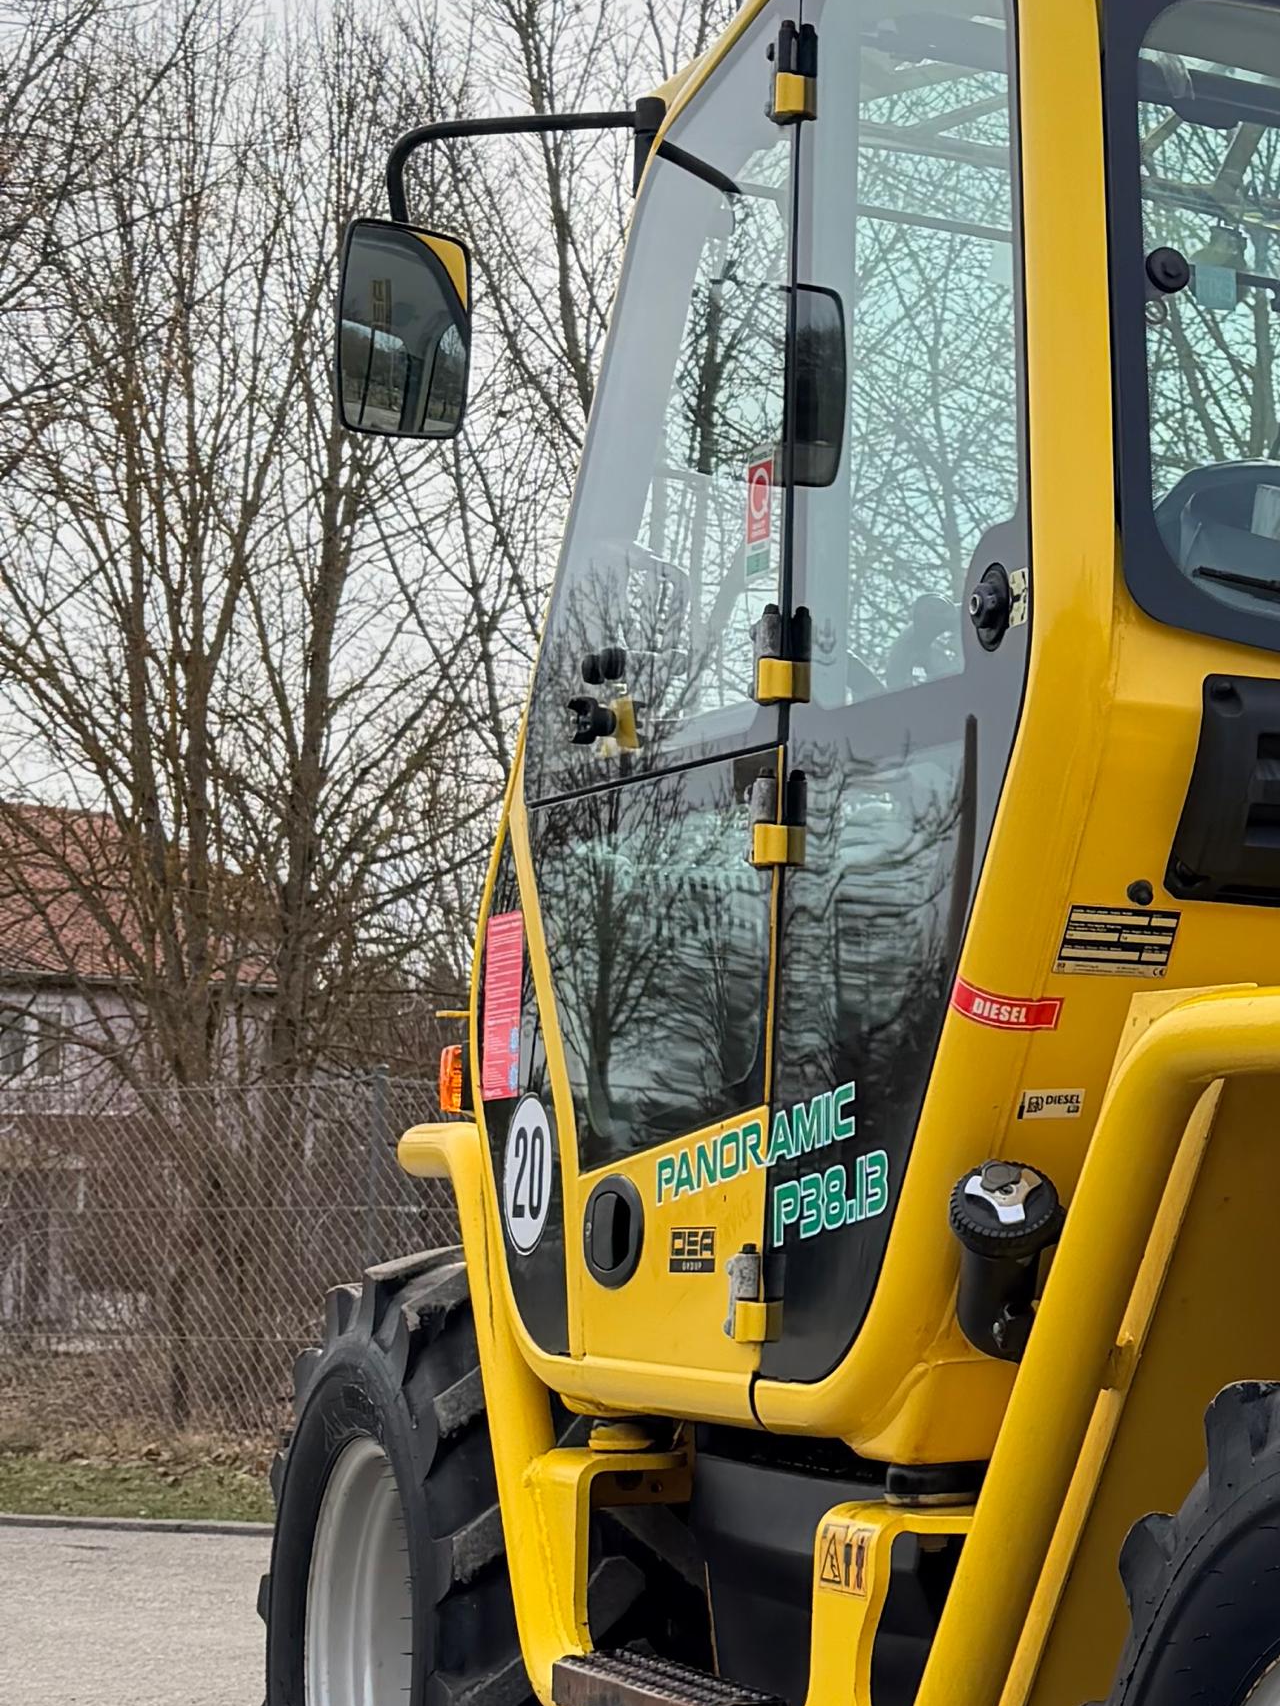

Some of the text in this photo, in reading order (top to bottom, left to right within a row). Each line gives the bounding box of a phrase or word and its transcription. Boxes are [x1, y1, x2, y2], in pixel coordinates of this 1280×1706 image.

[972, 997, 1027, 1023] DIESEL
[655, 1081, 856, 1207] PANORAMIC
[1046, 1095, 1081, 1105] DIESEL
[512, 1125, 545, 1220] 20
[773, 1149, 889, 1248] P38.13
